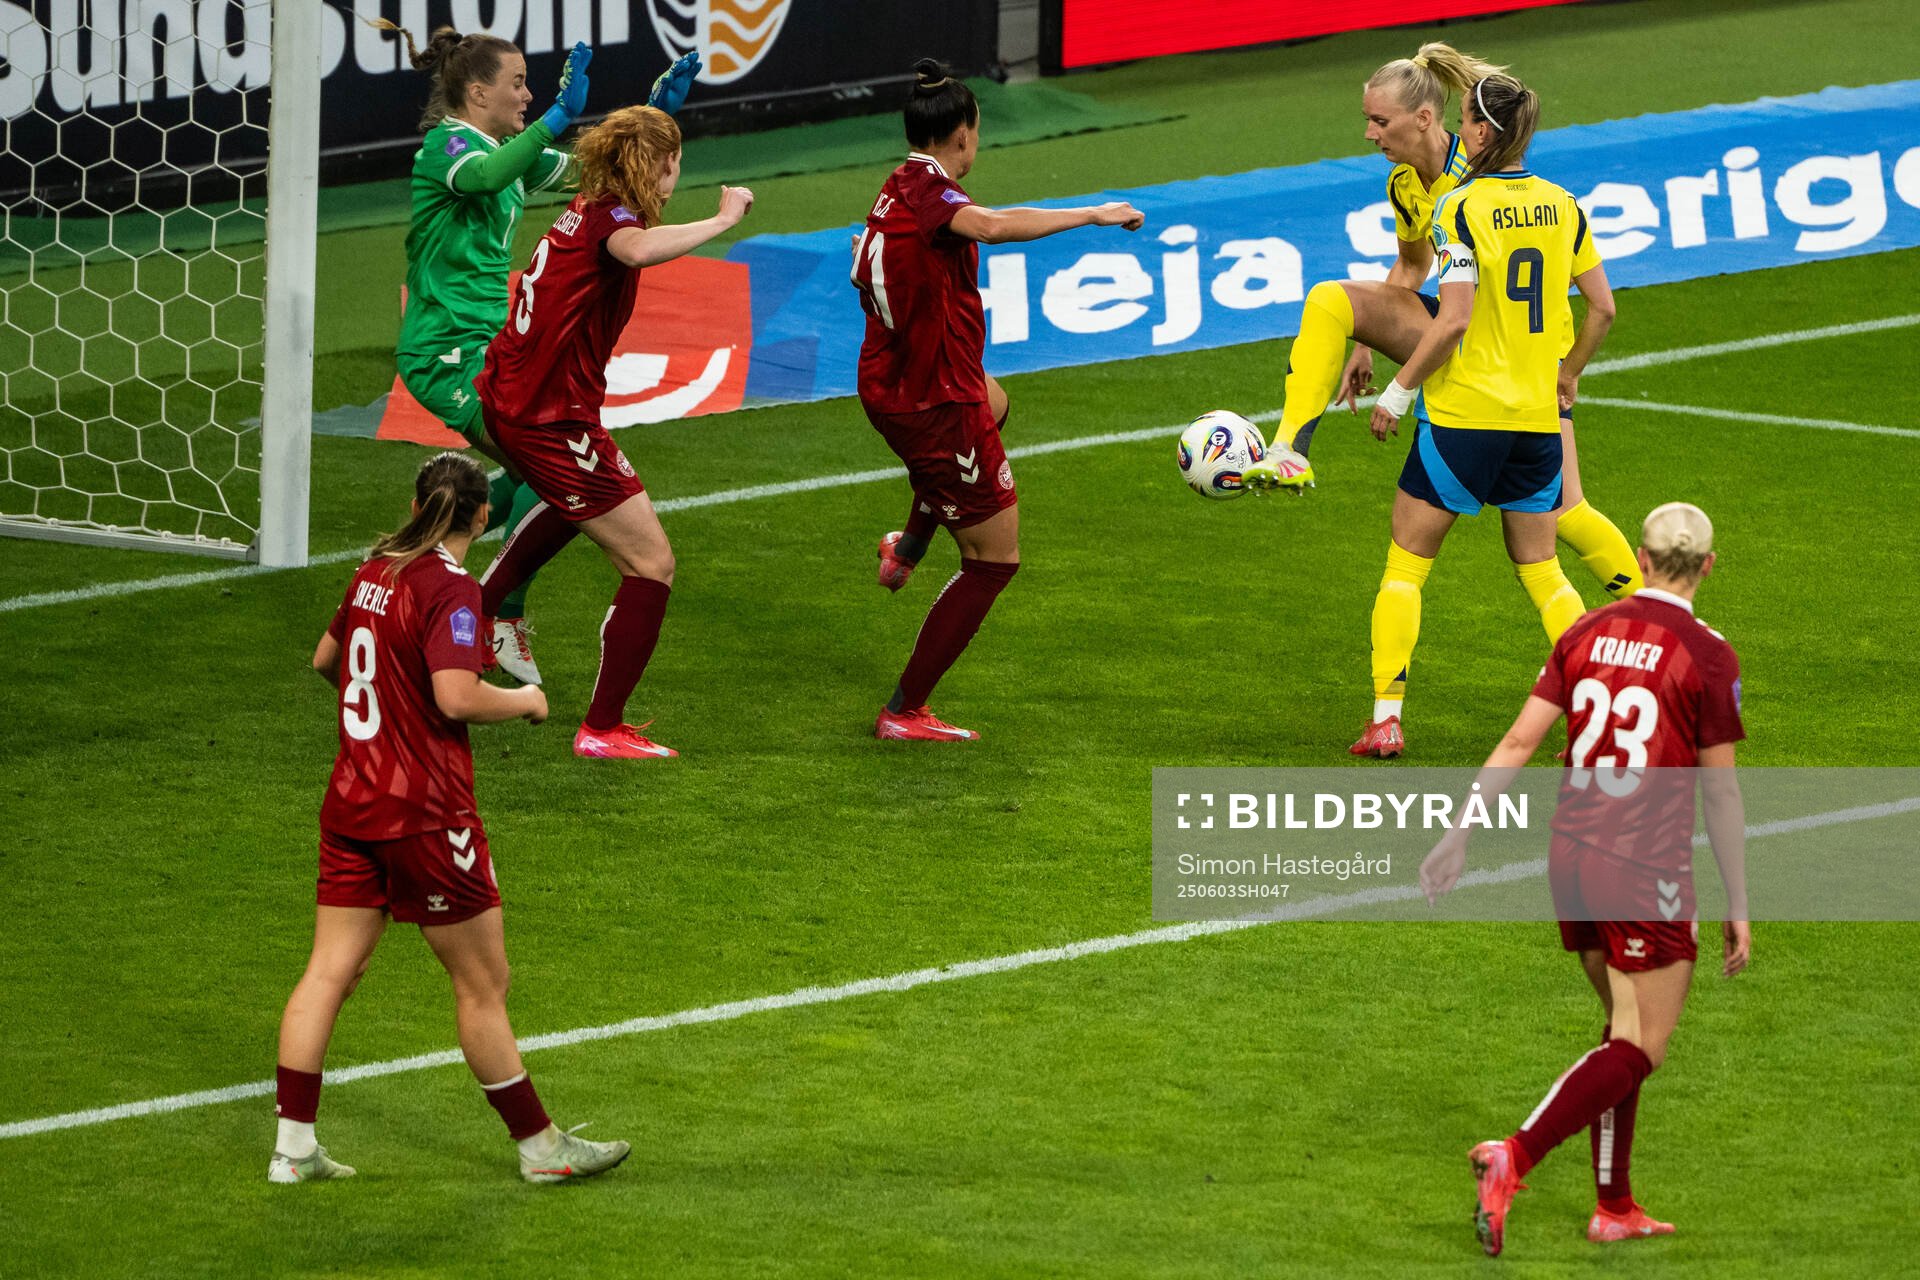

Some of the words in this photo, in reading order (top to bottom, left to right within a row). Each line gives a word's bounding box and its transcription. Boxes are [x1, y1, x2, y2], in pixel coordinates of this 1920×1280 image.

[1493, 204, 1559, 230] ASLLANI
[515, 238, 550, 335] 3
[850, 227, 895, 330] 11
[979, 223, 1306, 347] Heja
[1506, 247, 1544, 334] 9
[342, 626, 382, 741] 8
[1589, 635, 1664, 673] KRAMER
[1569, 677, 1660, 799] 23
